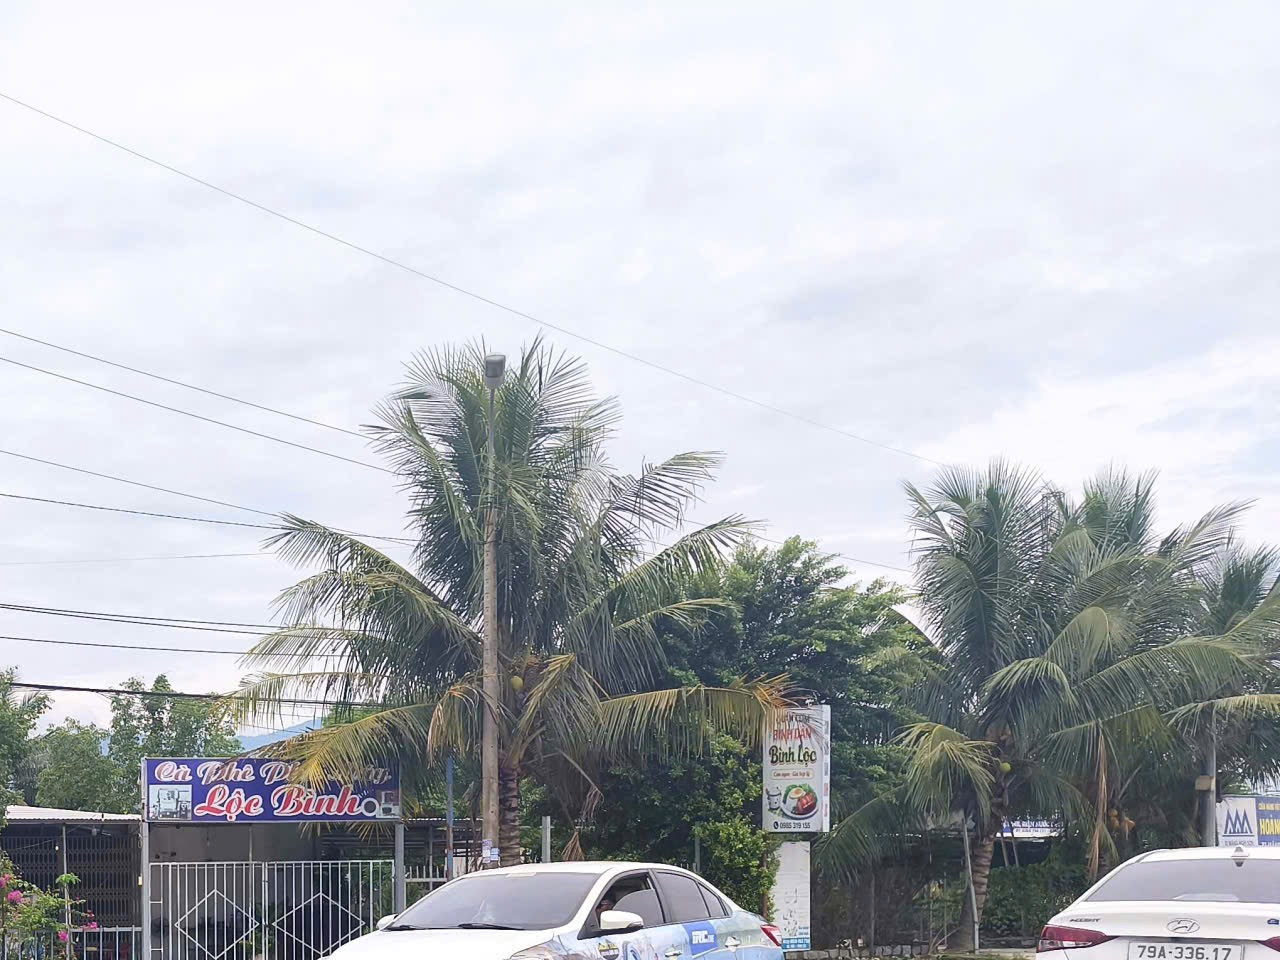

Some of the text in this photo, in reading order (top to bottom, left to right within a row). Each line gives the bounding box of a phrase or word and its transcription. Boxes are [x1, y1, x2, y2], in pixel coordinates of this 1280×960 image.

[769, 745, 795, 764] Bình
[798, 744, 817, 767] Lộc
[155, 761, 193, 782] Cà
[197, 761, 256, 785] Phê
[194, 784, 362, 821] Lộc Bình
[1137, 945, 1232, 960] 79A-336.17
